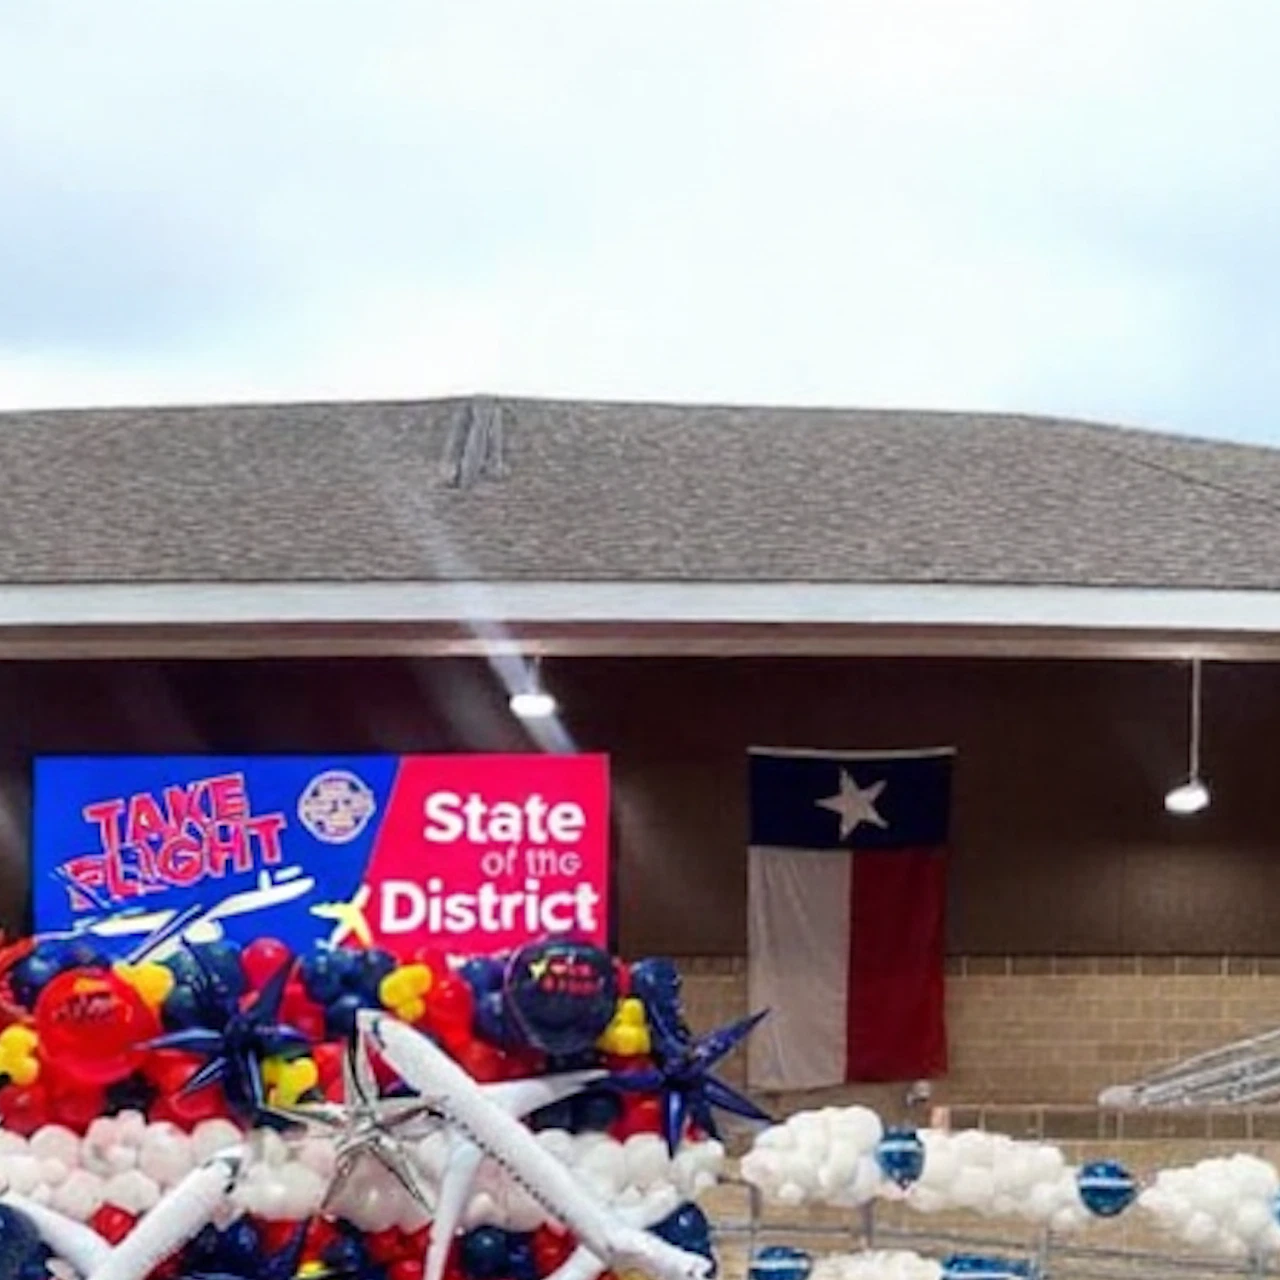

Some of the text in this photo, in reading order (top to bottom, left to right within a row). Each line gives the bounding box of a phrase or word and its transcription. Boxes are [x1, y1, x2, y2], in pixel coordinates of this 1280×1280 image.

[83, 772, 248, 852] TAKE
[422, 791, 587, 844] State
[64, 813, 287, 911] FLIGHT
[480, 847, 519, 878] of
[380, 877, 599, 934] District
